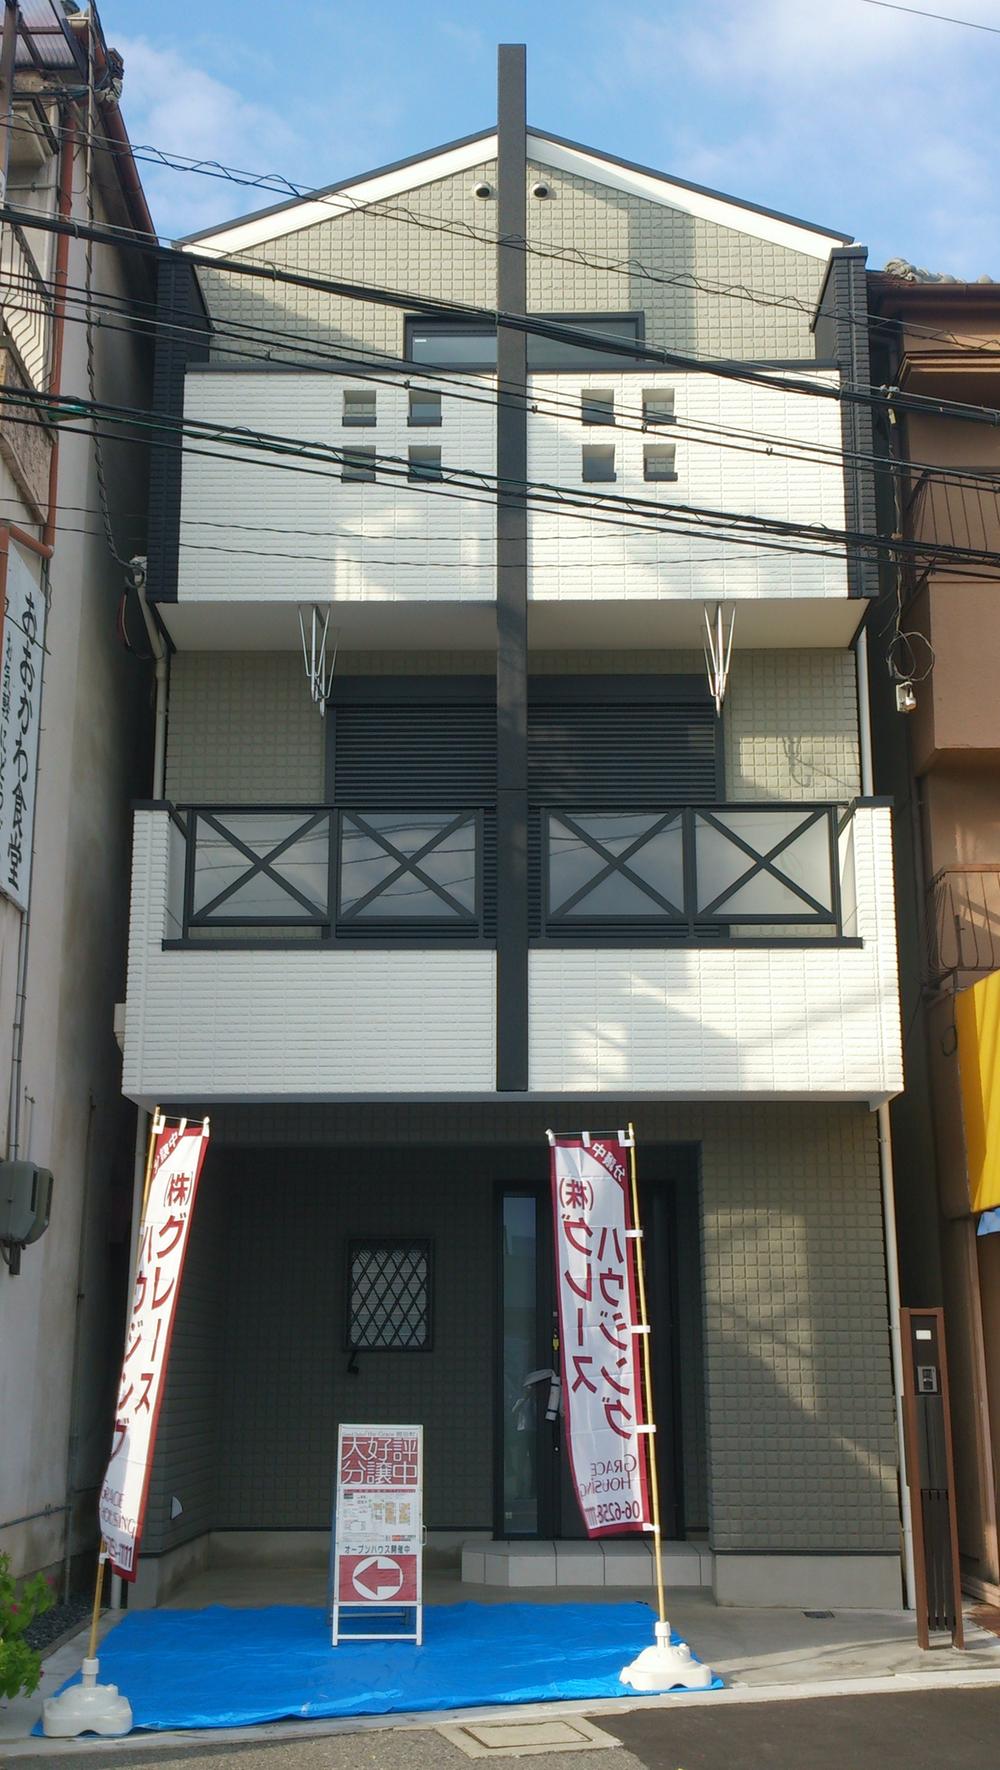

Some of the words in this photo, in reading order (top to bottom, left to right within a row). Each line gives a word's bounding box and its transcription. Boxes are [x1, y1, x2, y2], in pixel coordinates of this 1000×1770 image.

[342, 1437, 417, 1462] 大好評
[342, 1461, 417, 1484] 分譲中
